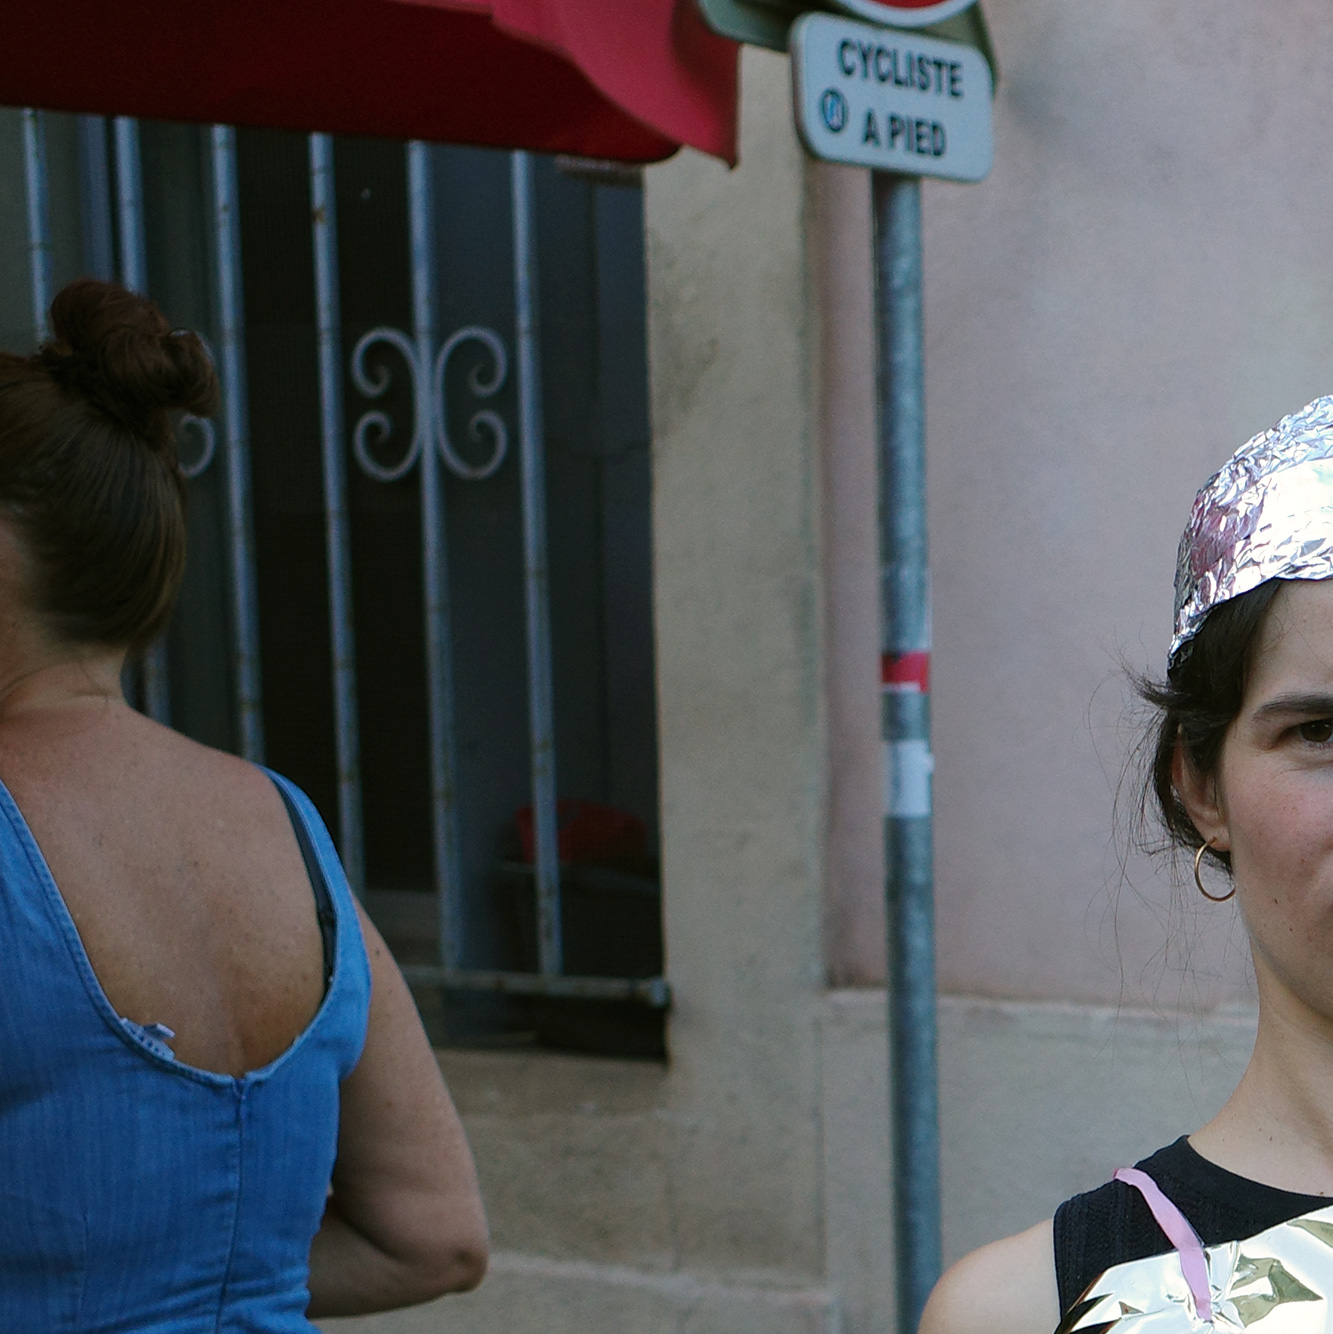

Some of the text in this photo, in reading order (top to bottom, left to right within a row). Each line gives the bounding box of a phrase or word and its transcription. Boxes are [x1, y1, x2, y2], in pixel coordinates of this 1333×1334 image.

[837, 39, 964, 98] CYCLISTE
[863, 108, 948, 157] A PIED
